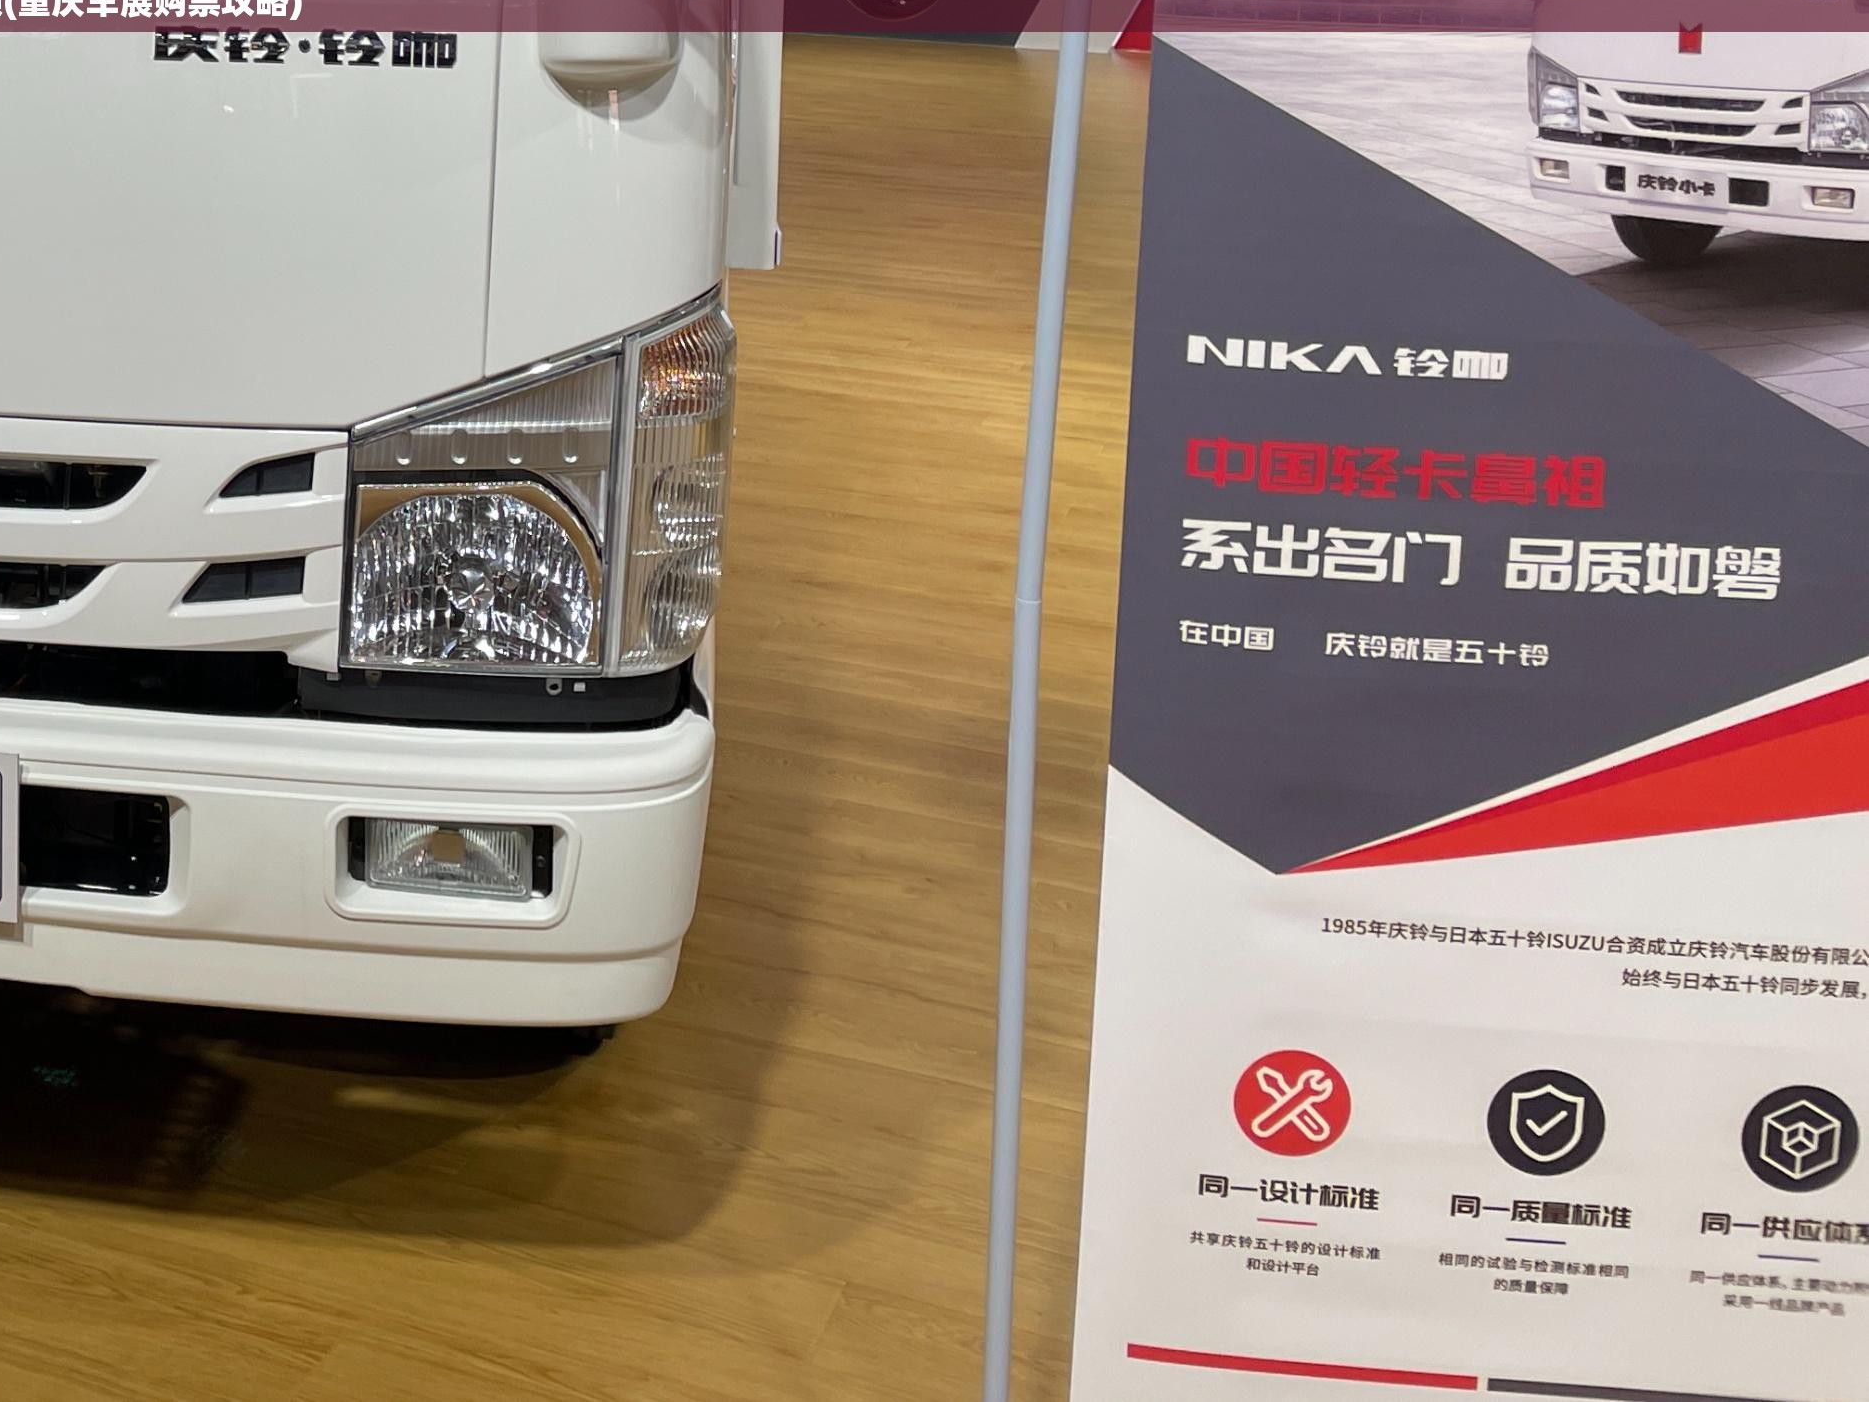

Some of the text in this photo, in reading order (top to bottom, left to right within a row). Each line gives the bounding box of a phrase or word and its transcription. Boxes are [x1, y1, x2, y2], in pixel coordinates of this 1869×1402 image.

[1637, 174, 1716, 196] 庆铃小卡
[1186, 334, 1509, 381] NIKA 铃咖
[1186, 437, 1606, 509] 中国轻卡鼻祖
[1181, 518, 1782, 601] 系出名门 品质如磐
[1179, 620, 1549, 668] 在中国 庆铃就是五十铃
[1321, 917, 1869, 966] 1985年庆铃与日本五十铃ISUZU合资成立庆铃汽车股份有限公
[1198, 1173, 1380, 1211] 同一设计标准
[1450, 1194, 1633, 1229] 同一质量标准
[1189, 1230, 1381, 1260] 共享庆铃五十铃的设计标准
[1246, 1256, 1319, 1277] 和设计平台
[1438, 1251, 1630, 1279] 相同的试验与检测标准相同
[1493, 1277, 1569, 1295] 的质量保障
